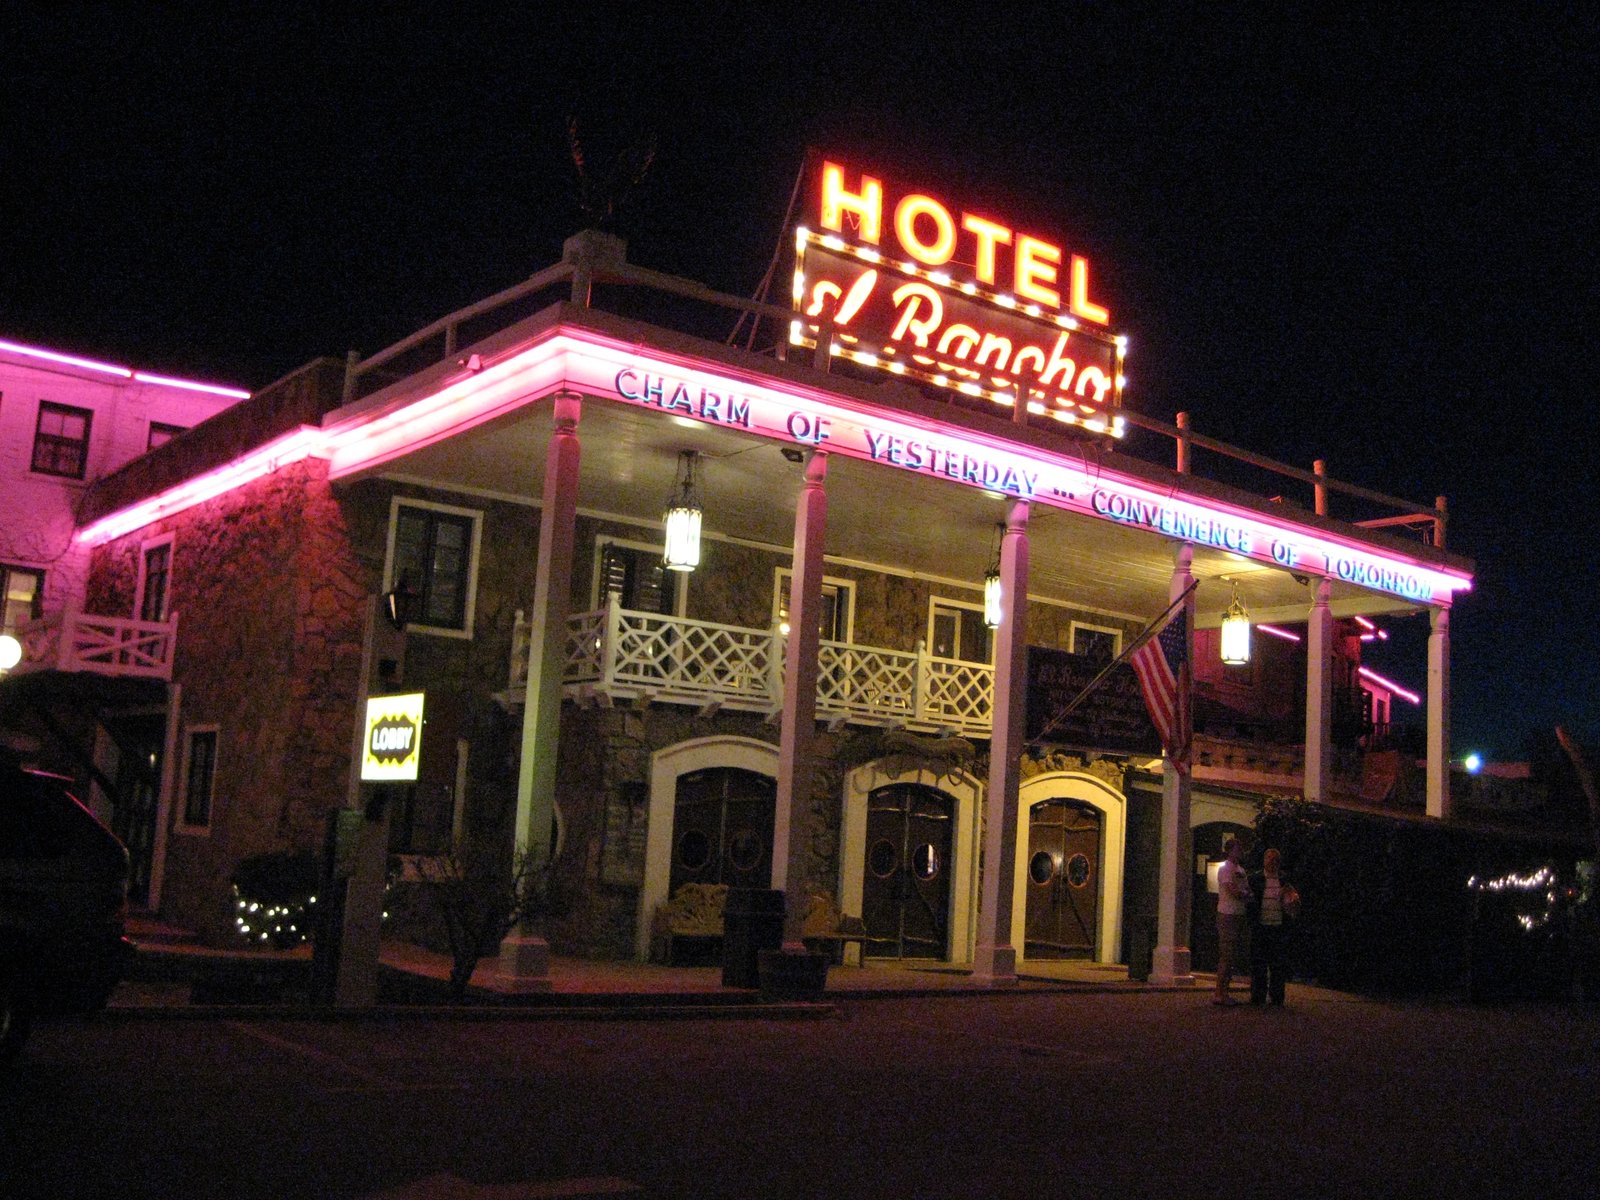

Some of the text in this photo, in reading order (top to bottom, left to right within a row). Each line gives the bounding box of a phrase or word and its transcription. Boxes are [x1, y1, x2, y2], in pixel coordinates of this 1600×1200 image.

[821, 160, 1109, 326] HOTEL
[884, 282, 1112, 414] Rancho
[614, 367, 753, 428] CHARM
[786, 410, 832, 445] OF
[863, 428, 1039, 498] YESTERDAY
[1091, 488, 1253, 555] CONVENIENCE
[1271, 539, 1300, 568] OF
[1321, 551, 1433, 600] TOMORROW
[372, 726, 414, 751] LOBBY
